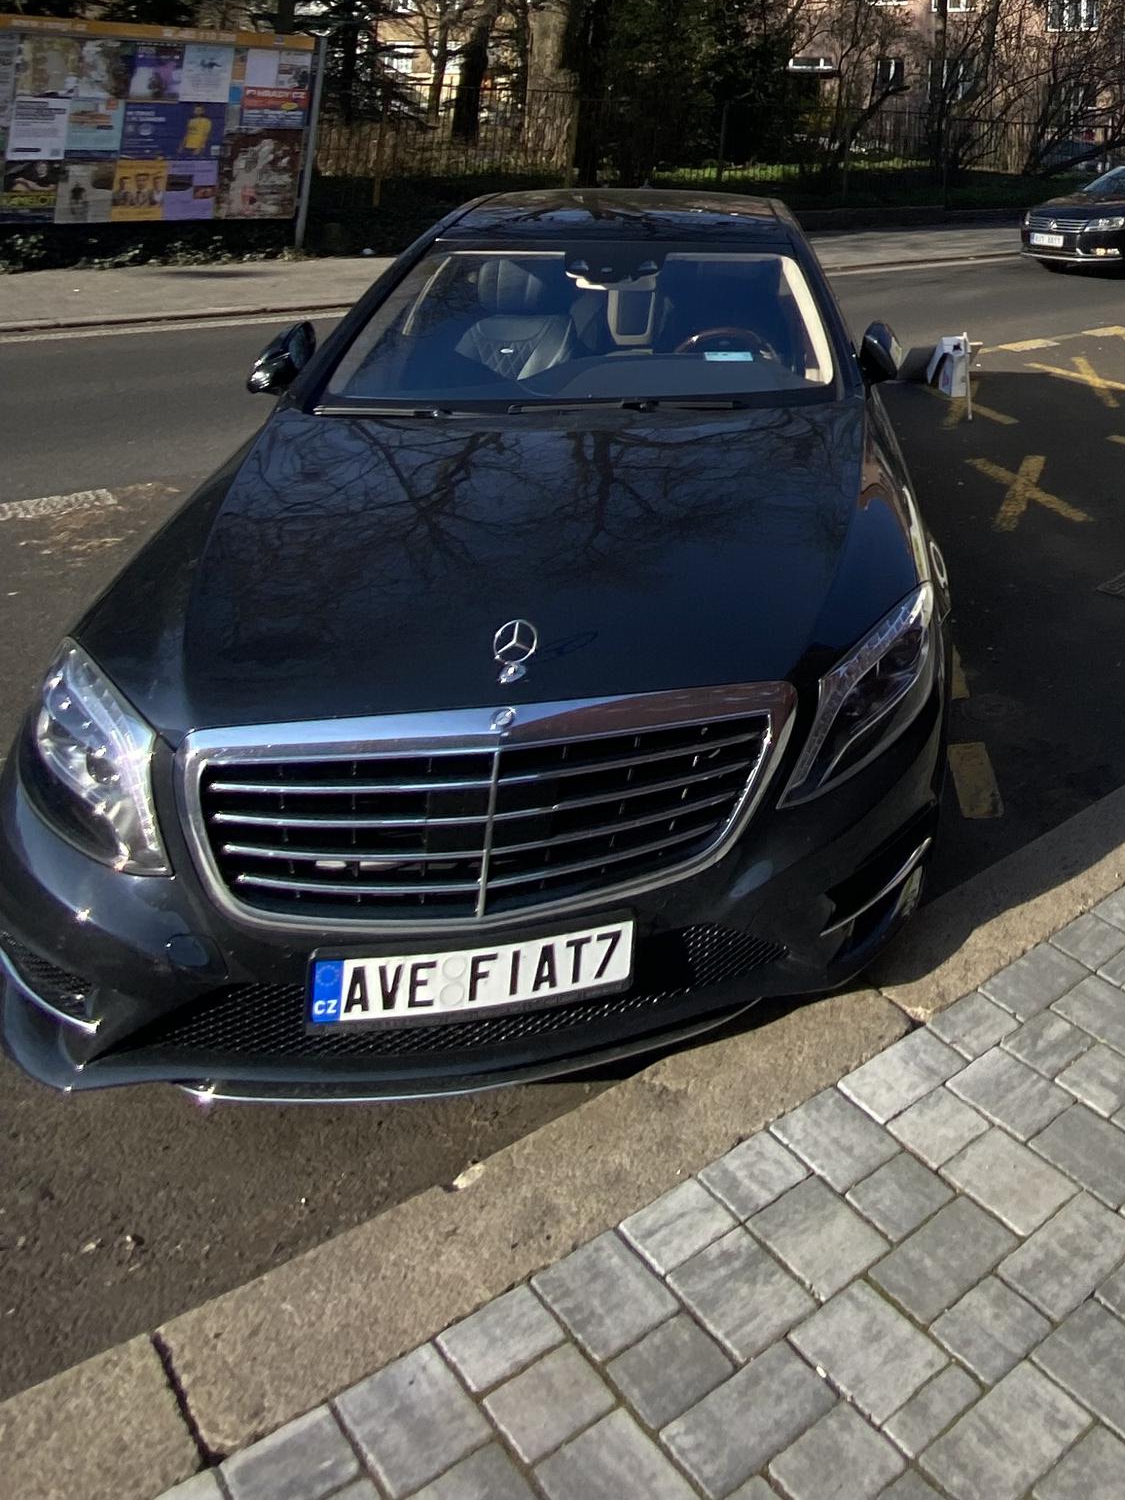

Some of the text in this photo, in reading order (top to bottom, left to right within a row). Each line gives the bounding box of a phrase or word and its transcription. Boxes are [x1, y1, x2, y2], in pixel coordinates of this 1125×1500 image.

[312, 930, 622, 1015] CZ AVE FIAT7
